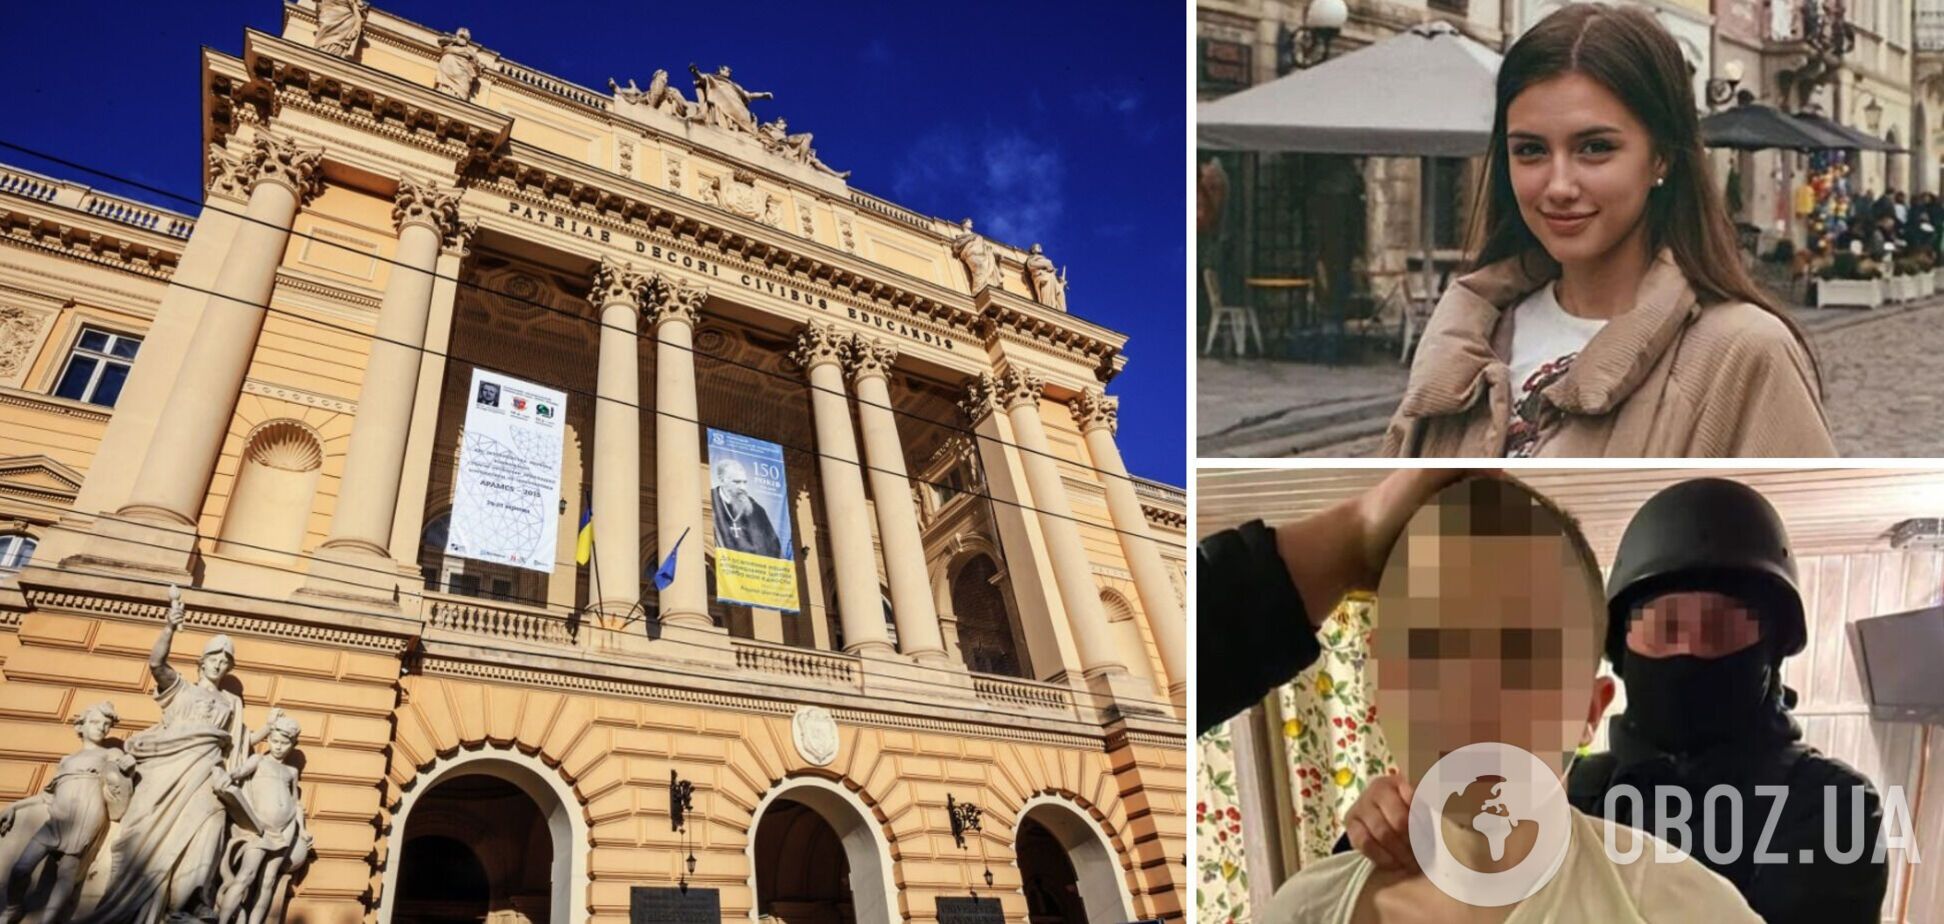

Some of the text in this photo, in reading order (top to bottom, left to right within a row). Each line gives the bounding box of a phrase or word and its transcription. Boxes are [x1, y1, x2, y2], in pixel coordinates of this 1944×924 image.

[509, 203, 954, 350] PATRIAE DECORI CIVIBUS EDUCANDIS
[753, 461, 780, 480] 150
[480, 480, 515, 492] APAMCS
